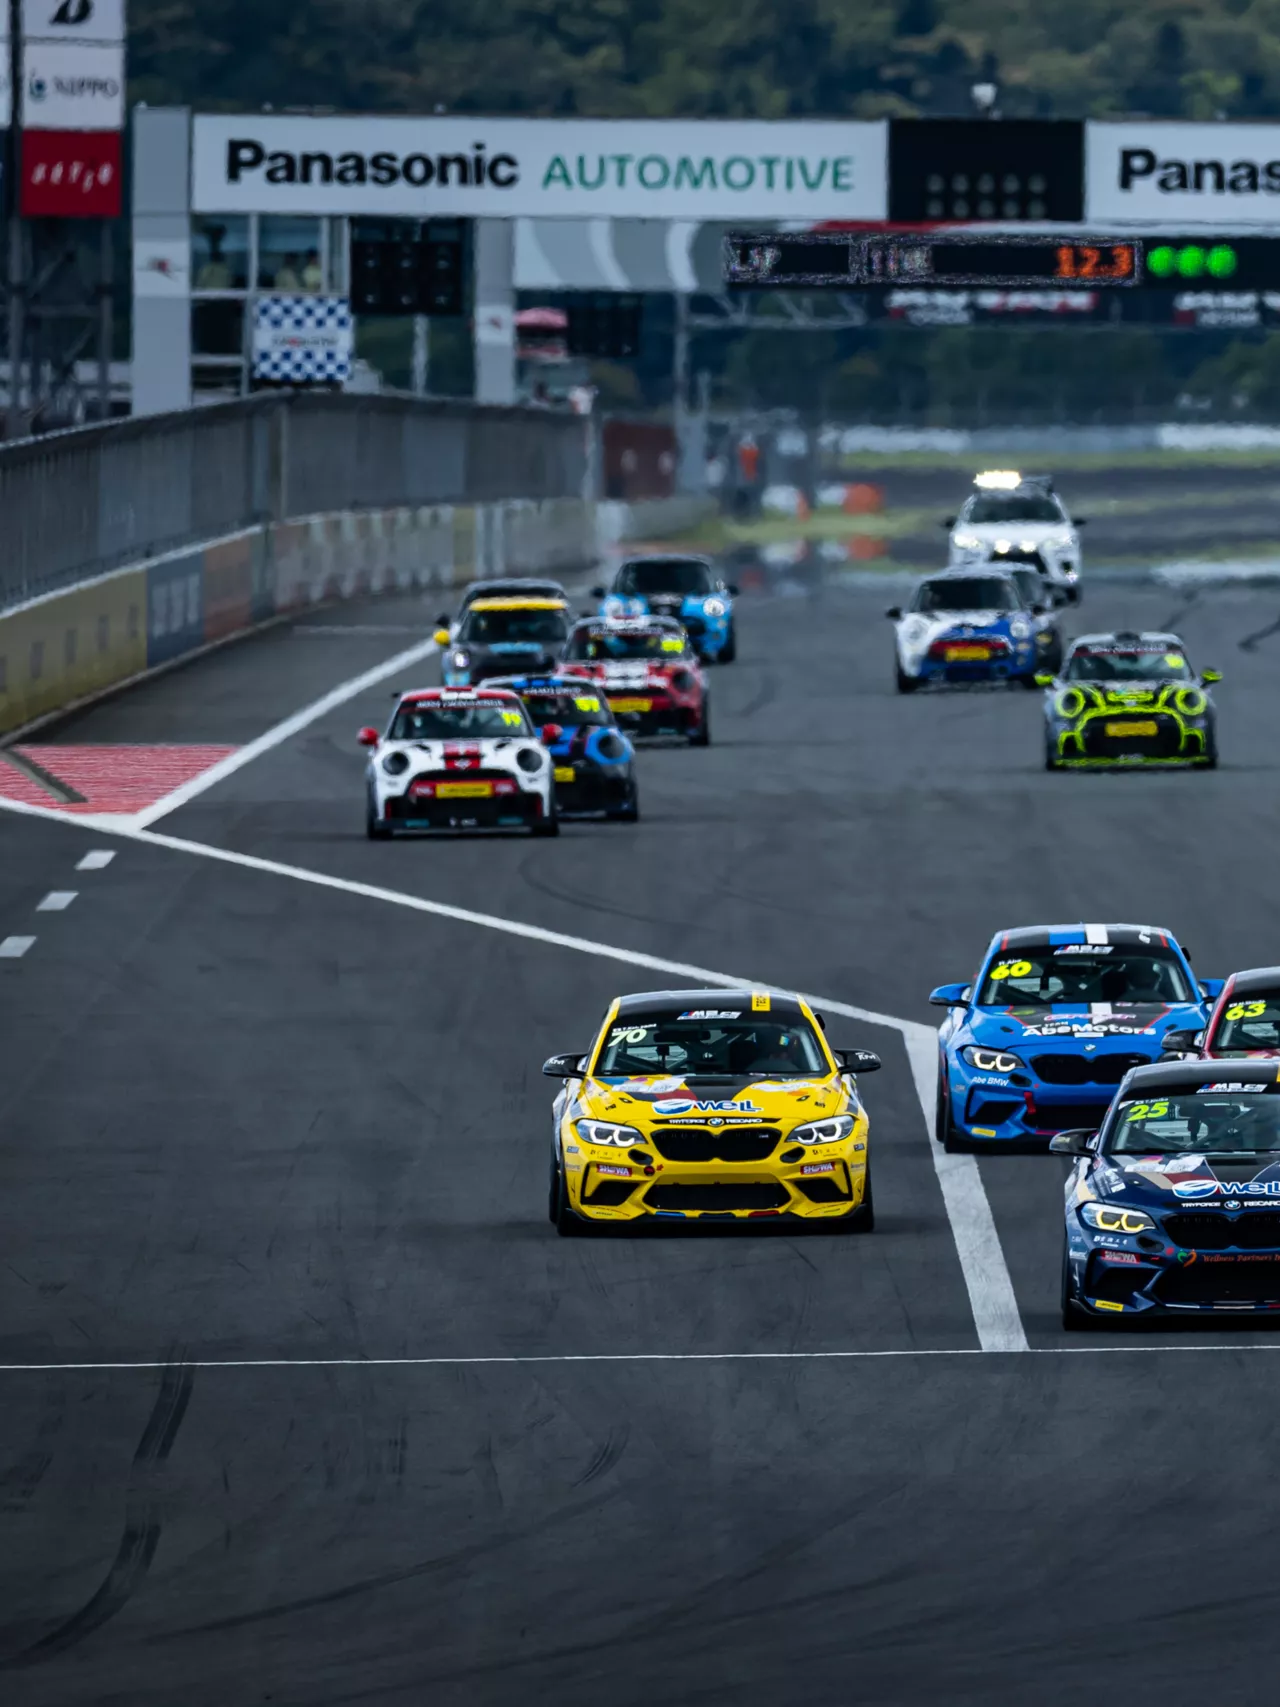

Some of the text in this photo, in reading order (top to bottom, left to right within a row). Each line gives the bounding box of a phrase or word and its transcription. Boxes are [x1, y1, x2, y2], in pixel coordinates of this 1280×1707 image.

[227, 139, 855, 192] Panasonic AUTOMOTIVE
[990, 961, 1032, 980] 60
[1225, 1003, 1267, 1021] 63
[607, 1029, 648, 1048] 70
[1022, 1024, 1157, 1037] AbeMotors
[971, 1076, 1009, 1087] Abe BMW
[1126, 1101, 1169, 1121] 25
[803, 1162, 834, 1175] SHOWA
[1203, 1254, 1235, 1262] Wellness
